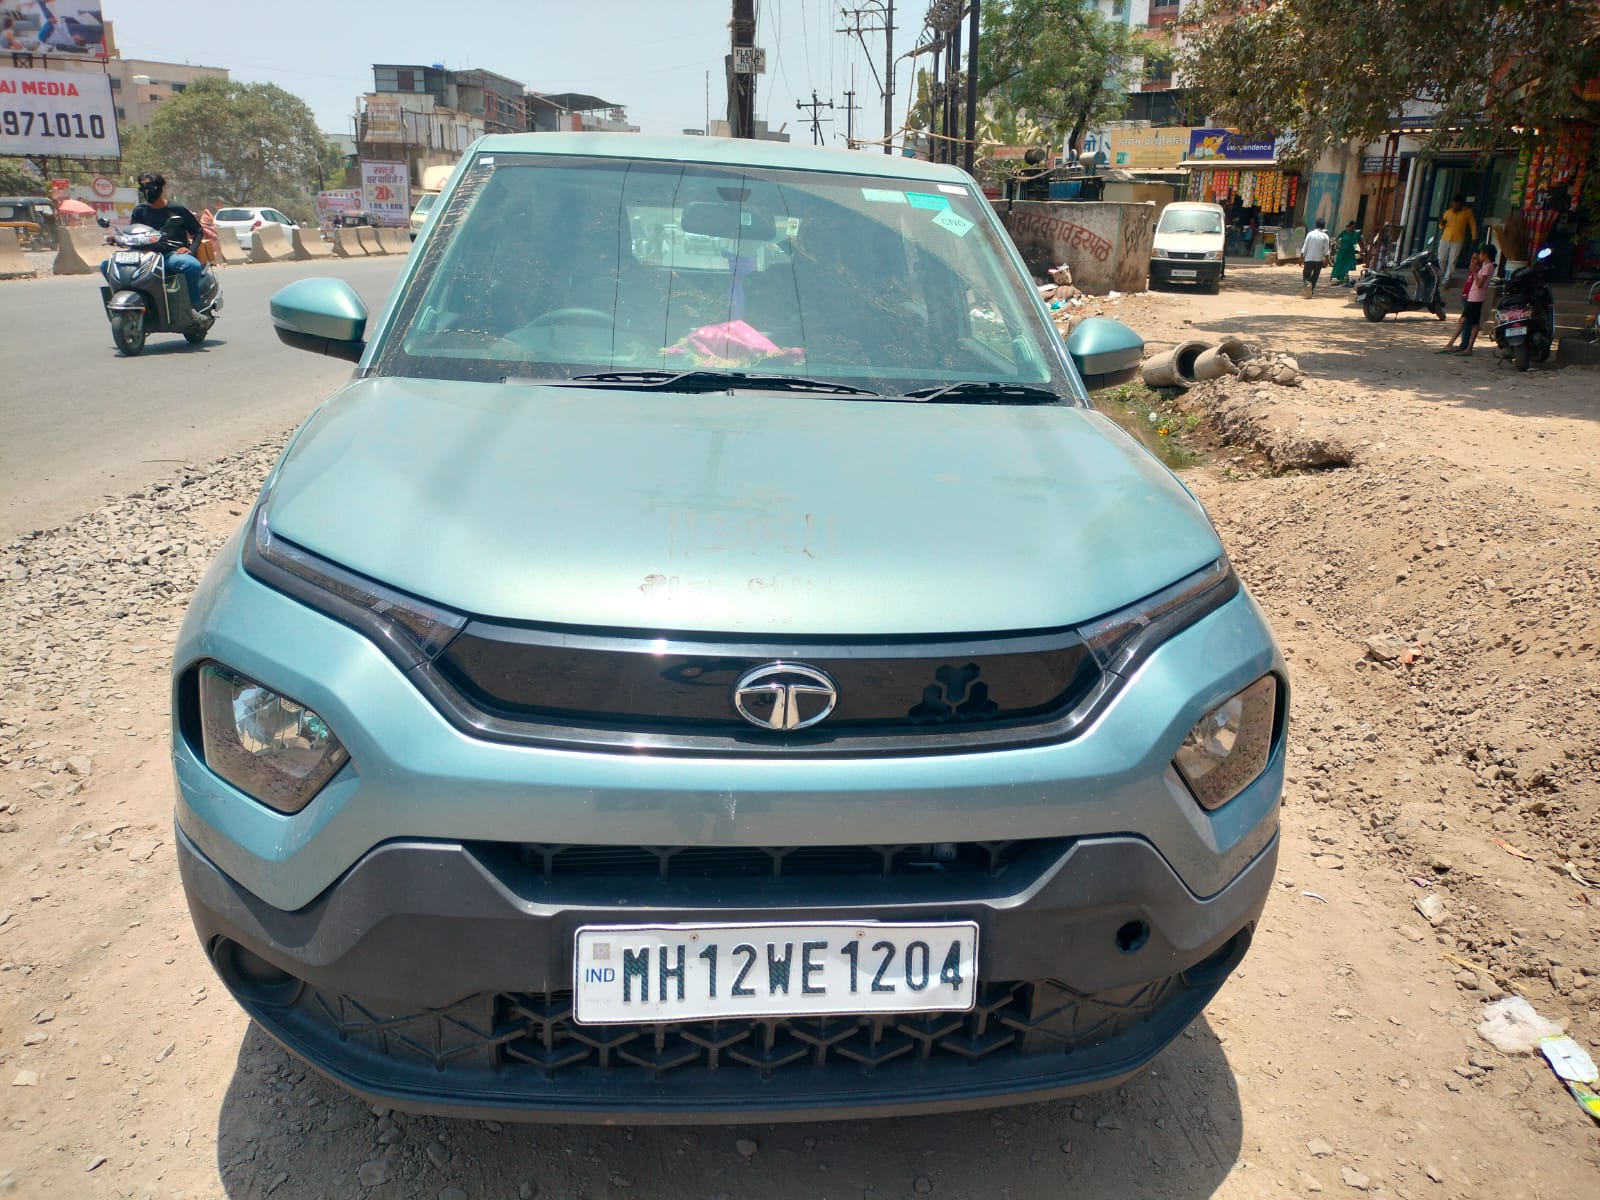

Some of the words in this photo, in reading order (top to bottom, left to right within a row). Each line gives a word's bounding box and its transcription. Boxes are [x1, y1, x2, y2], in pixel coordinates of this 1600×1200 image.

[21, 81, 79, 97] MEDIA
[0, 110, 105, 139] 971010
[941, 217, 966, 228] CNG
[585, 967, 615, 983] IND
[623, 940, 963, 1002] MH12WE1204
